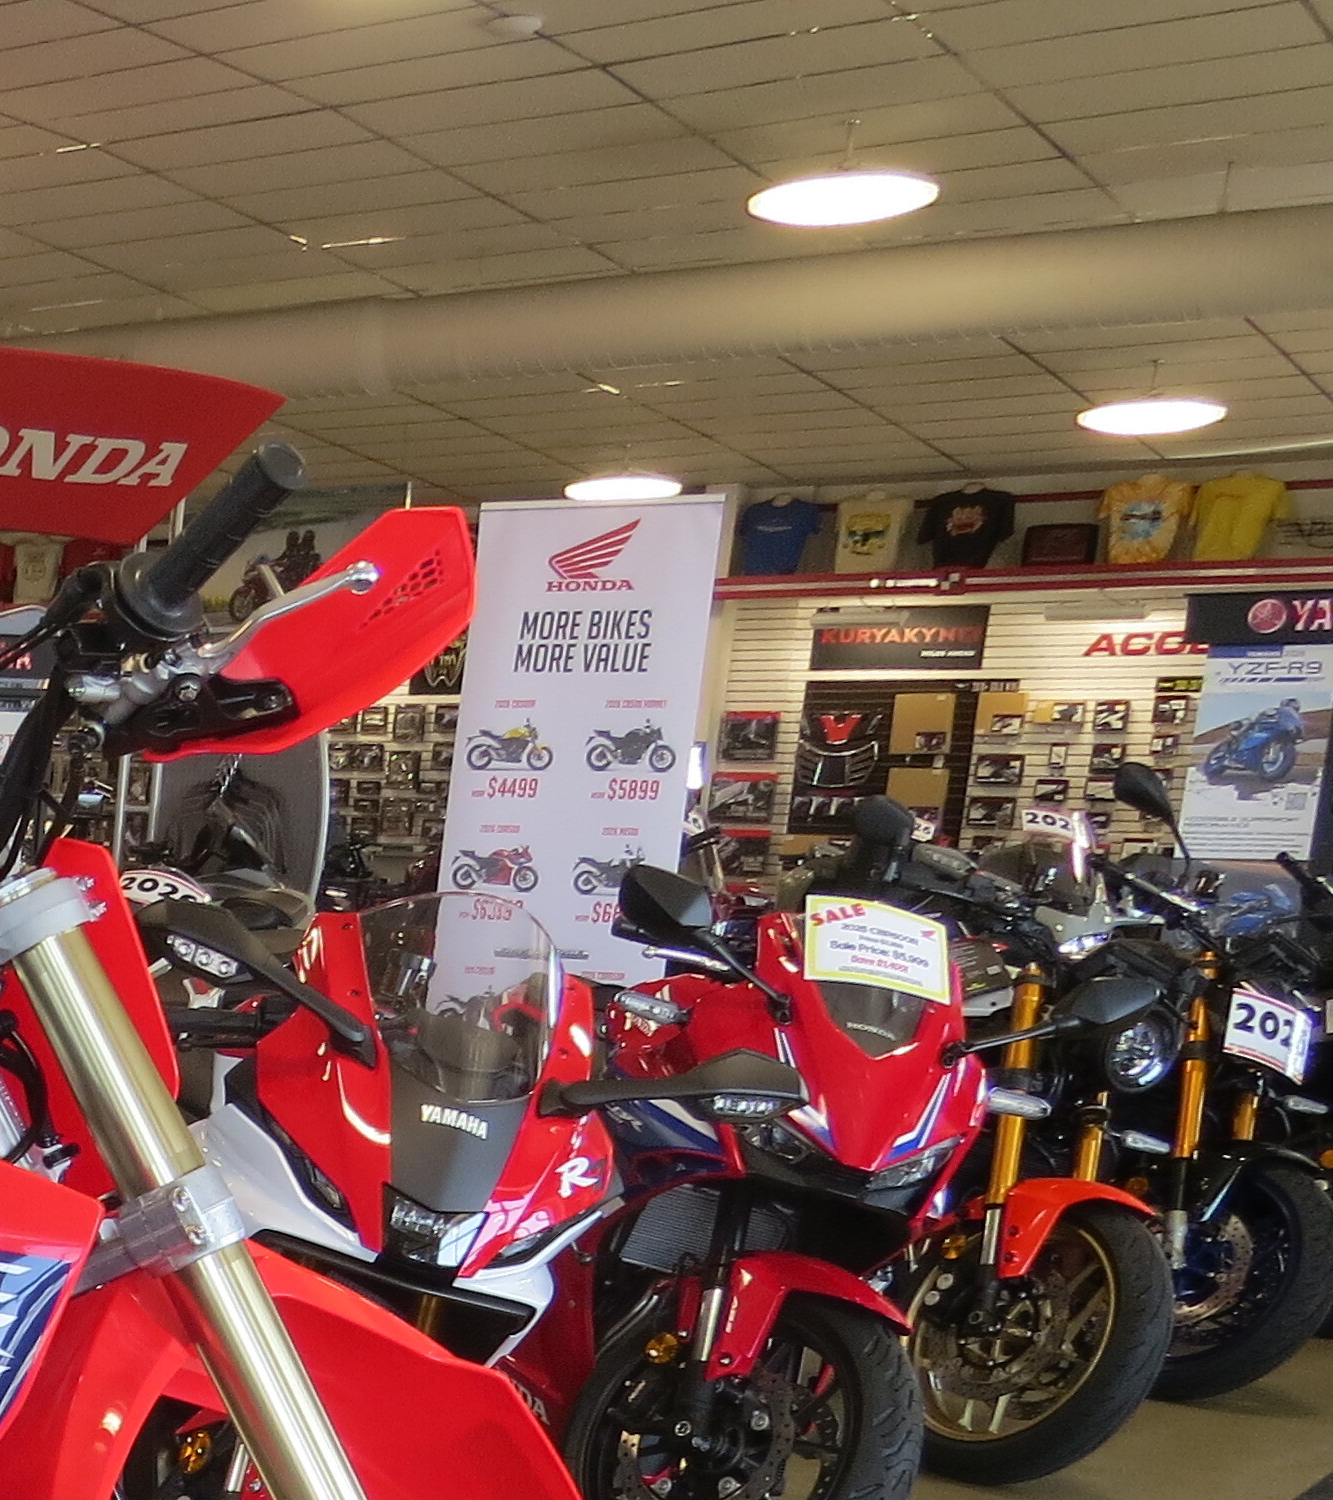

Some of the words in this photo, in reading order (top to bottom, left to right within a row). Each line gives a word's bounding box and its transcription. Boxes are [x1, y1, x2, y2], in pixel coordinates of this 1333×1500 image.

[545, 579, 634, 592] HONDA
[519, 610, 583, 640] MORE
[587, 608, 653, 640] BIKES
[514, 643, 577, 673] MORE
[583, 643, 651, 673] VALUE
[1227, 660, 1323, 675] YZF-R9
[487, 776, 539, 799] $4499
[607, 777, 661, 801] $5899
[1024, 811, 1074, 833] 202
[810, 903, 866, 926] SALE
[1232, 1002, 1294, 1048] 202
[420, 1103, 489, 1140] YAMAHA
